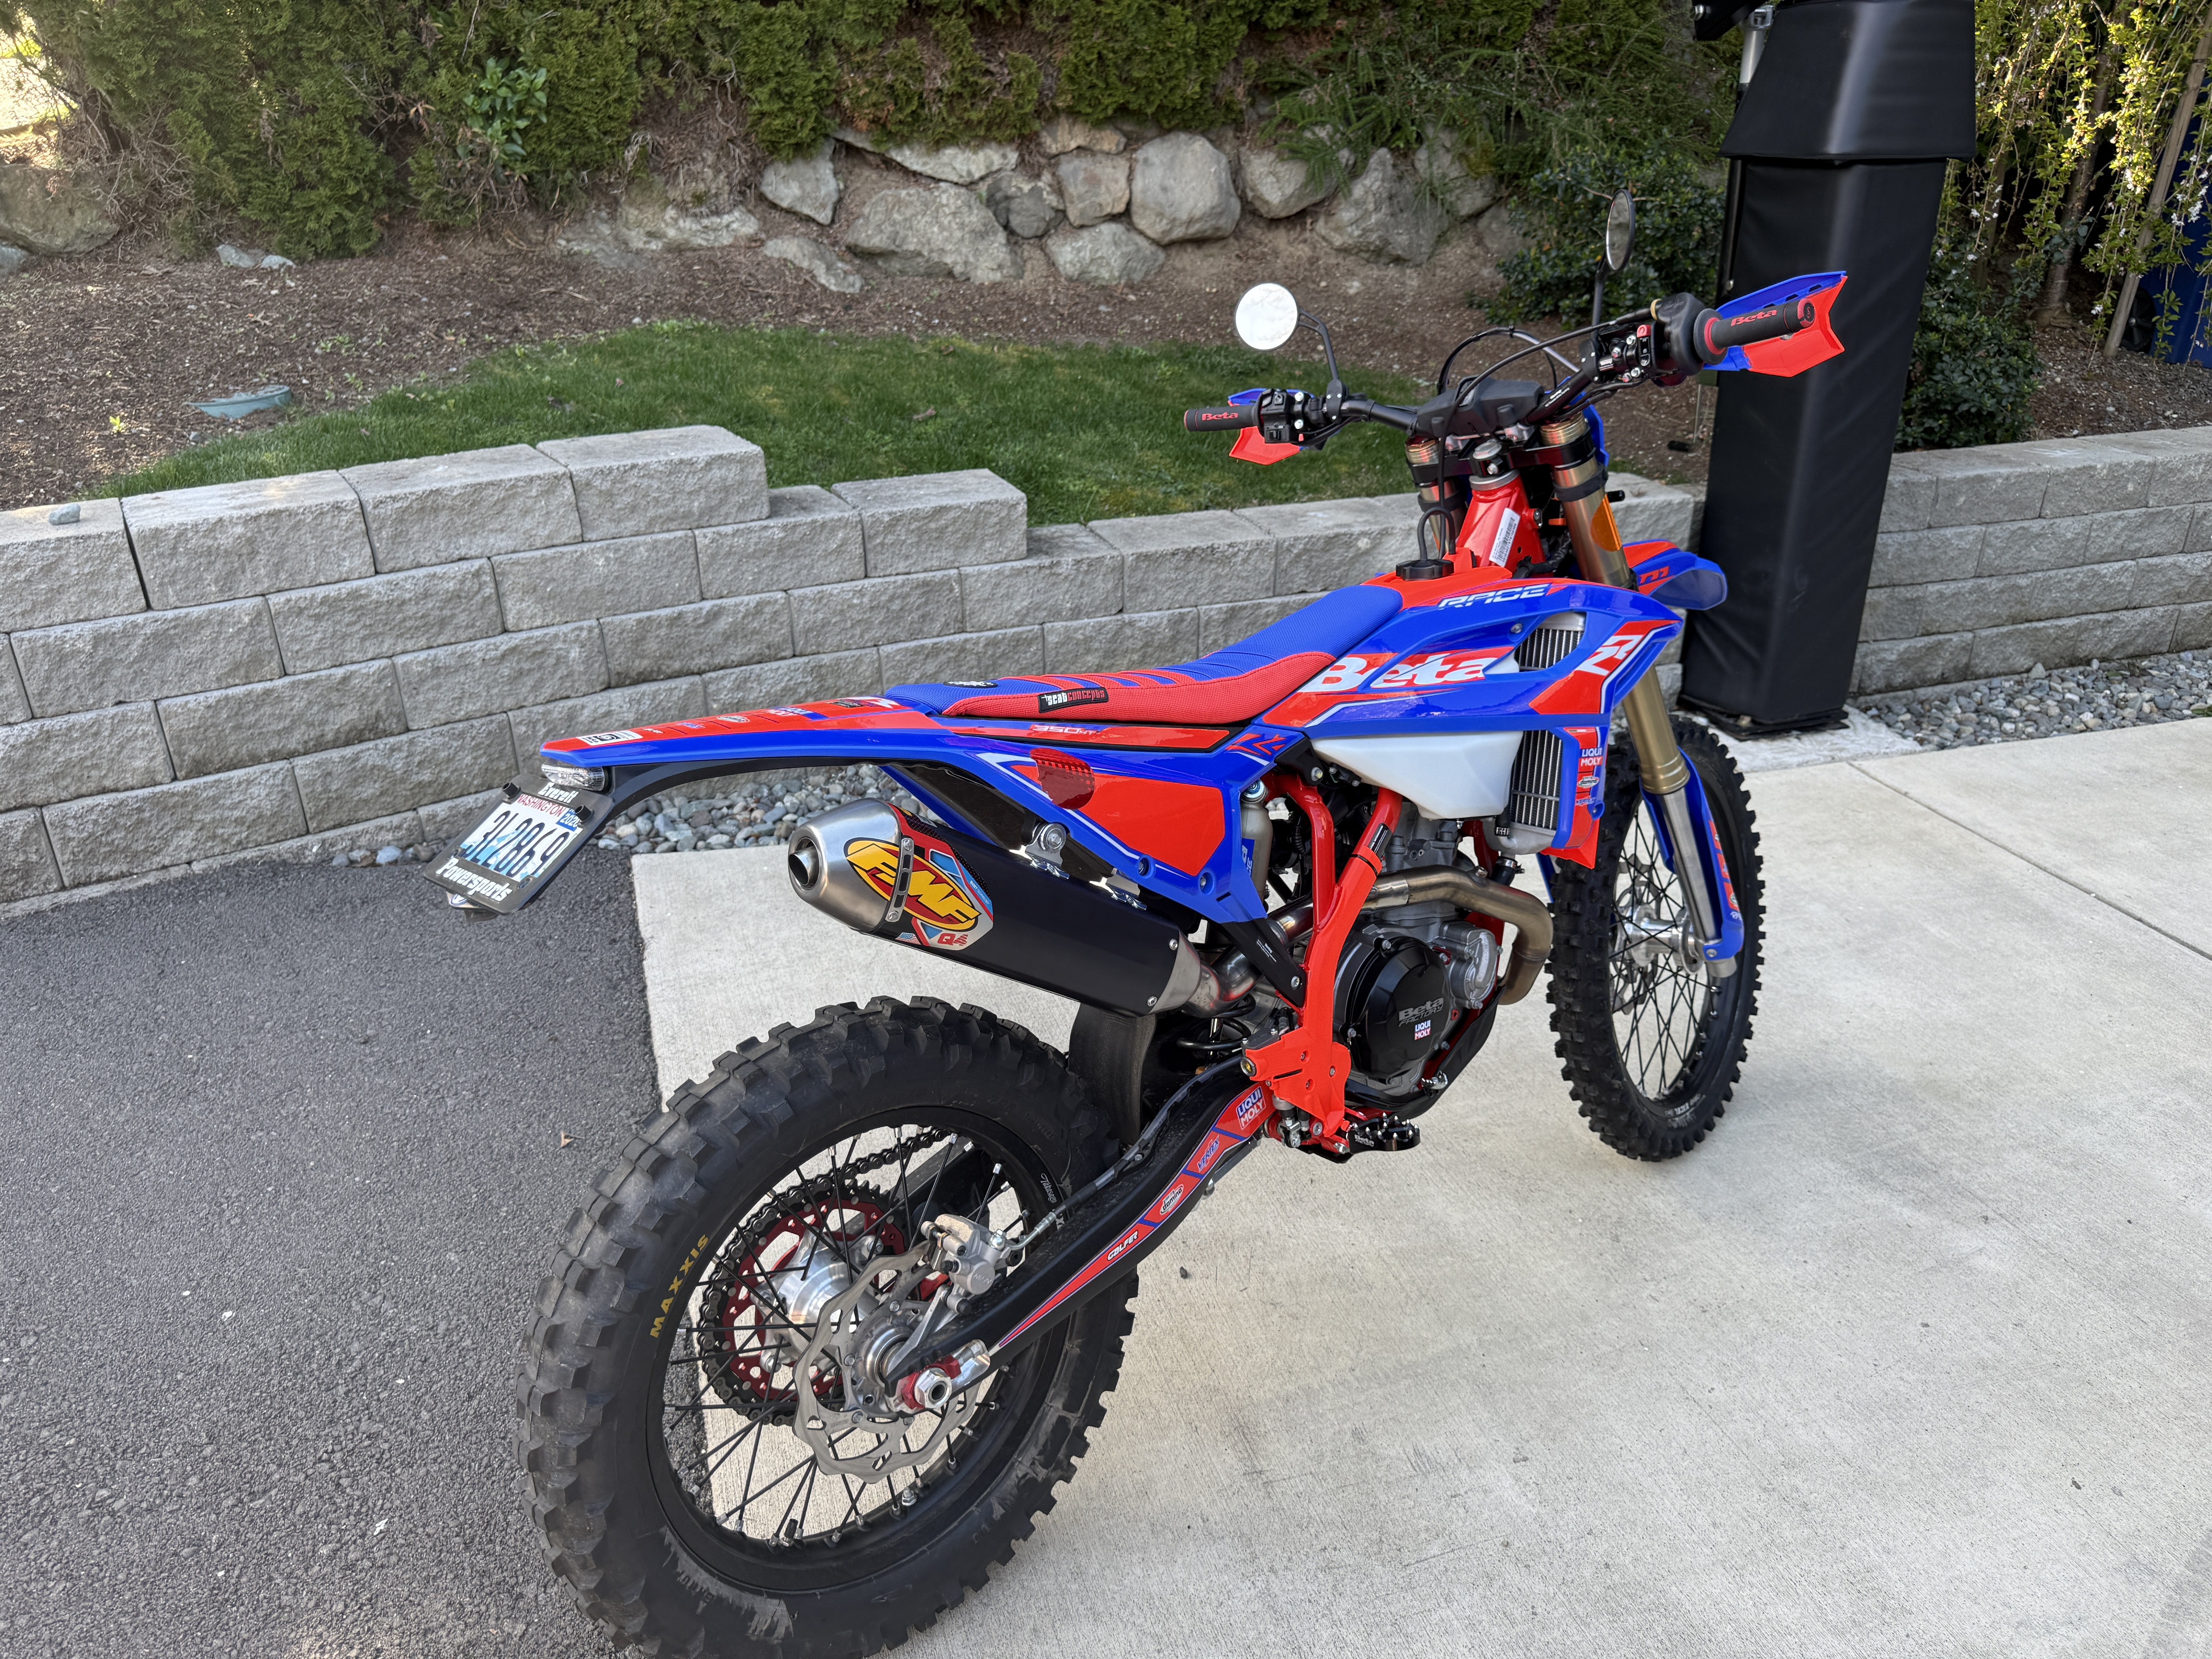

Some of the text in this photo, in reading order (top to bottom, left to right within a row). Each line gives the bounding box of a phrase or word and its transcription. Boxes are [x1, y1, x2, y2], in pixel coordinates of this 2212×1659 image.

[1731, 309, 1777, 327] Beta
[1202, 412, 1239, 421] Beta
[1437, 584, 1549, 610] RACE
[1297, 653, 1498, 692] Beta
[1580, 757, 1601, 767] MOLY
[1581, 747, 1602, 757] LIQUI
[538, 782, 579, 804] Everett
[459, 810, 570, 878] 3L2869
[436, 857, 512, 902] Powersports
[846, 843, 982, 924] FMF
[1398, 1004, 1444, 1027] FACTORY
[1399, 997, 1444, 1022] Beta
[1414, 1027, 1431, 1041] MOLY
[1415, 1020, 1431, 1032] LIQUI
[1238, 1088, 1262, 1117] LIQUI
[1240, 1099, 1264, 1127] MOLY
[1354, 1134, 1374, 1145] Beta
[1197, 1139, 1219, 1172] VERTEX
[1040, 1173, 1057, 1203] Takasago
[1163, 1187, 1182, 1211] domino
[650, 1234, 709, 1338] MAXXIS
